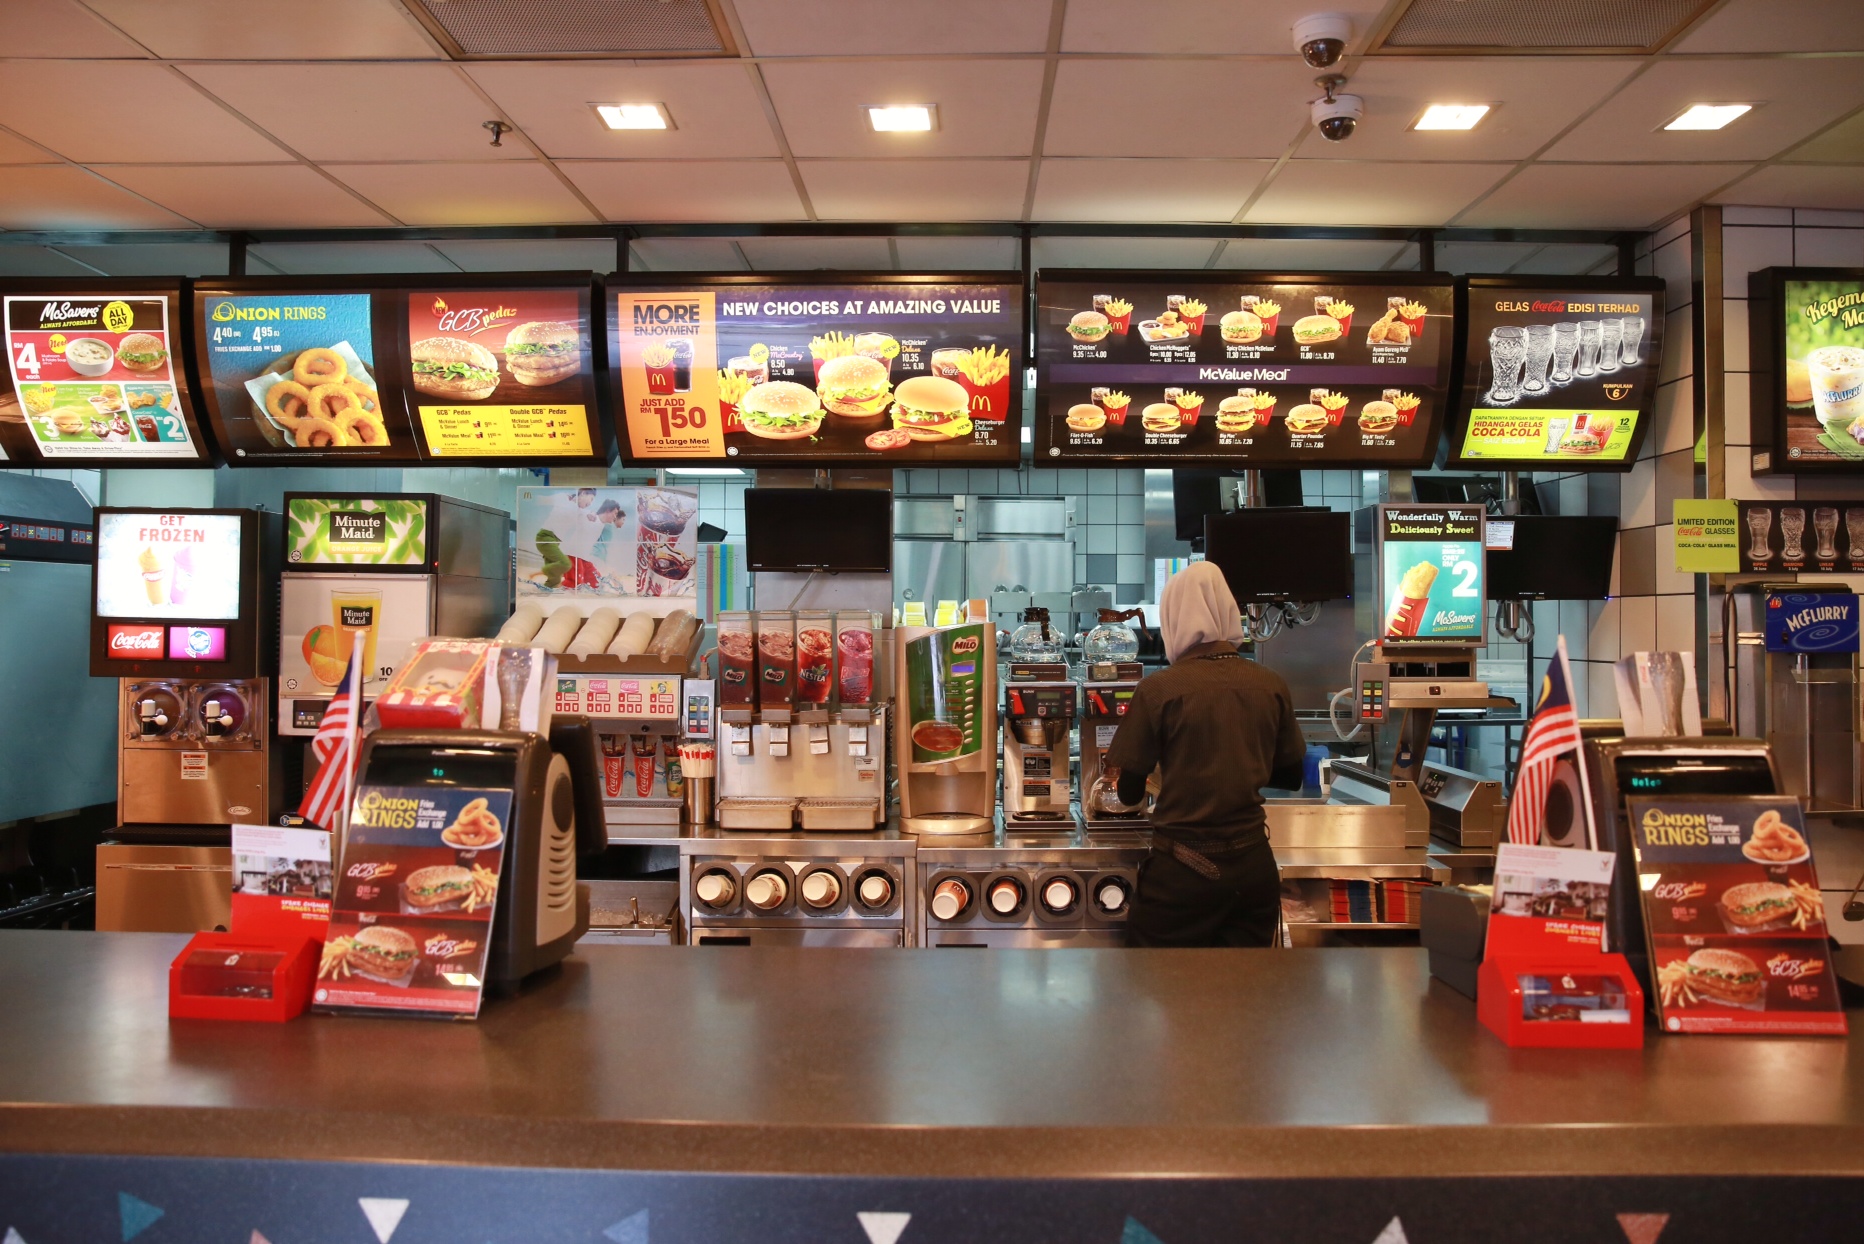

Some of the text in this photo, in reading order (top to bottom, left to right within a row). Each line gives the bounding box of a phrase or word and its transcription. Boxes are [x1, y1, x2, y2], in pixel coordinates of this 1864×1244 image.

[40, 302, 99, 321] McSavers
[212, 302, 326, 322] ONION RINGS
[723, 299, 1000, 315] NEW CHOICES AT AMAZING VALUE
[1495, 300, 1640, 313] GELAS Coca-Cola EDISI TERHAD
[109, 309, 126, 318] ALL
[438, 305, 517, 332] GCB pedas
[634, 304, 700, 324] MORE
[62, 319, 97, 328] AFFORDABLE
[110, 317, 127, 326] DAY
[634, 325, 700, 336] ENJOYMENT
[753, 349, 767, 358] NEW
[884, 344, 897, 353] NEW
[16, 343, 41, 374] 4
[771, 360, 786, 368] 8.50
[902, 354, 919, 362] 10.35
[782, 368, 795, 376] 4.80
[1199, 368, 1288, 380] McValue Meal
[1612, 389, 1620, 397] 6
[640, 399, 662, 407] JUST
[38, 417, 60, 437] 3
[163, 416, 184, 438] 2
[1472, 428, 1541, 437] COCA-COLA
[665, 438, 688, 446] Large
[160, 516, 185, 525] GET
[335, 515, 380, 527] Minute
[1386, 510, 1478, 522] Wonderfully Warm
[139, 528, 205, 542] FROZEN
[341, 527, 374, 539] Maid
[1390, 523, 1474, 535] Deliciously Sweet
[1452, 561, 1478, 597] 2
[344, 610, 370, 618] Minute
[1432, 611, 1475, 626] McSavers
[111, 631, 162, 649] Coca-Cola
[953, 641, 977, 650] MILO
[726, 672, 743, 680] MILO
[765, 672, 783, 680] MILO
[800, 669, 826, 682] NESTEA
[608, 761, 618, 794] Coca-Cola
[638, 761, 649, 795] Coca-Cola
[361, 792, 434, 810] ONION Fries
[418, 809, 447, 817] Exchange
[1642, 808, 1723, 828] ONION Fries
[1708, 824, 1740, 833] Exchange
[1643, 826, 1725, 846] RINGS Add
[347, 863, 375, 878] GCB
[1655, 883, 1684, 899] GCB
[425, 940, 455, 955] GCB
[1770, 960, 1800, 976] GCB
